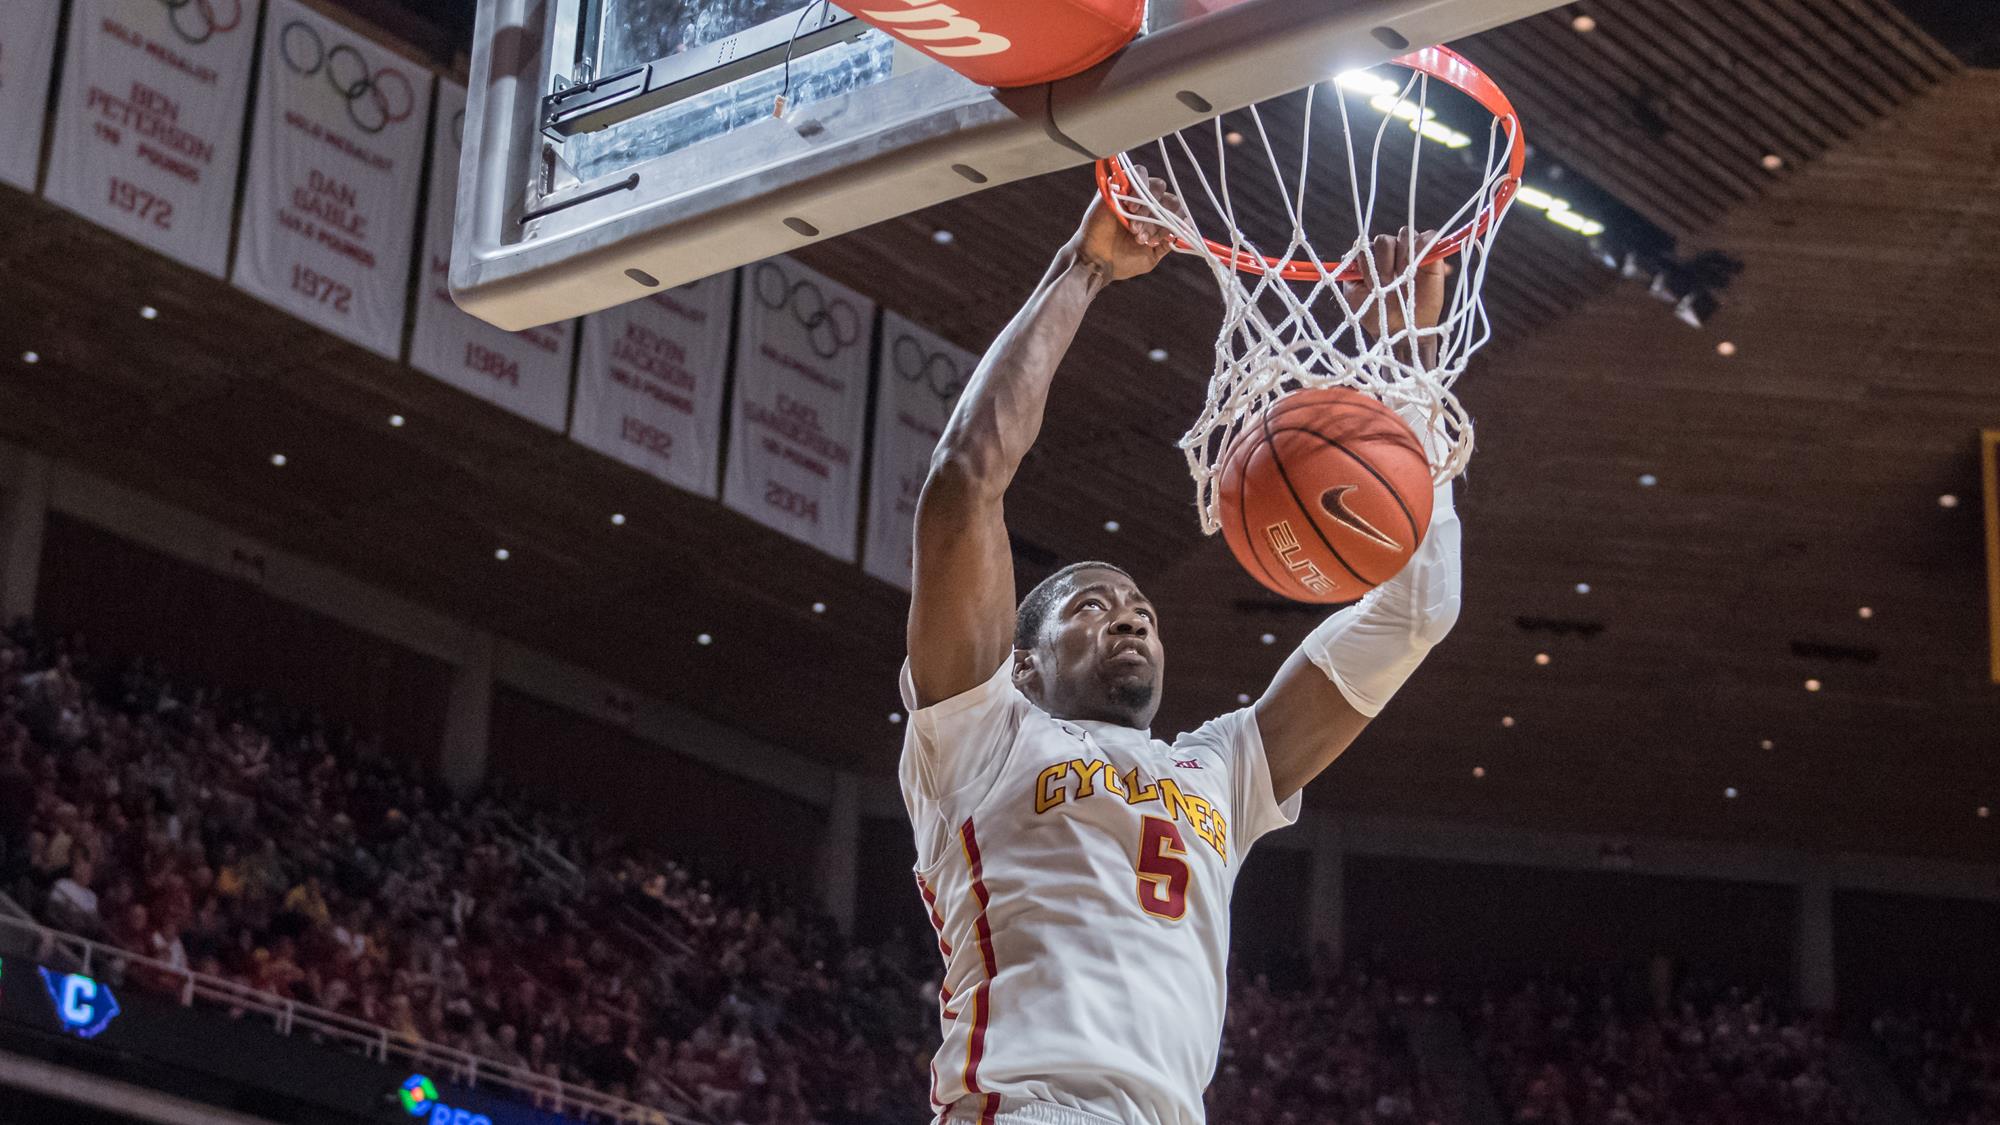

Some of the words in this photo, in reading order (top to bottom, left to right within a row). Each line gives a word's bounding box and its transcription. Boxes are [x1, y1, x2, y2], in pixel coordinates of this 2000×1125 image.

[88, 86, 215, 165] PETERSON
[131, 81, 180, 121] BEN
[110, 176, 173, 230] 1972
[308, 169, 357, 208] DAN
[292, 263, 352, 313] 1972
[466, 341, 519, 388] 1984
[622, 417, 673, 459] 1992
[1266, 520, 1341, 596] ELITE
[1136, 814, 1192, 922] 5
[64, 973, 97, 1025] C
